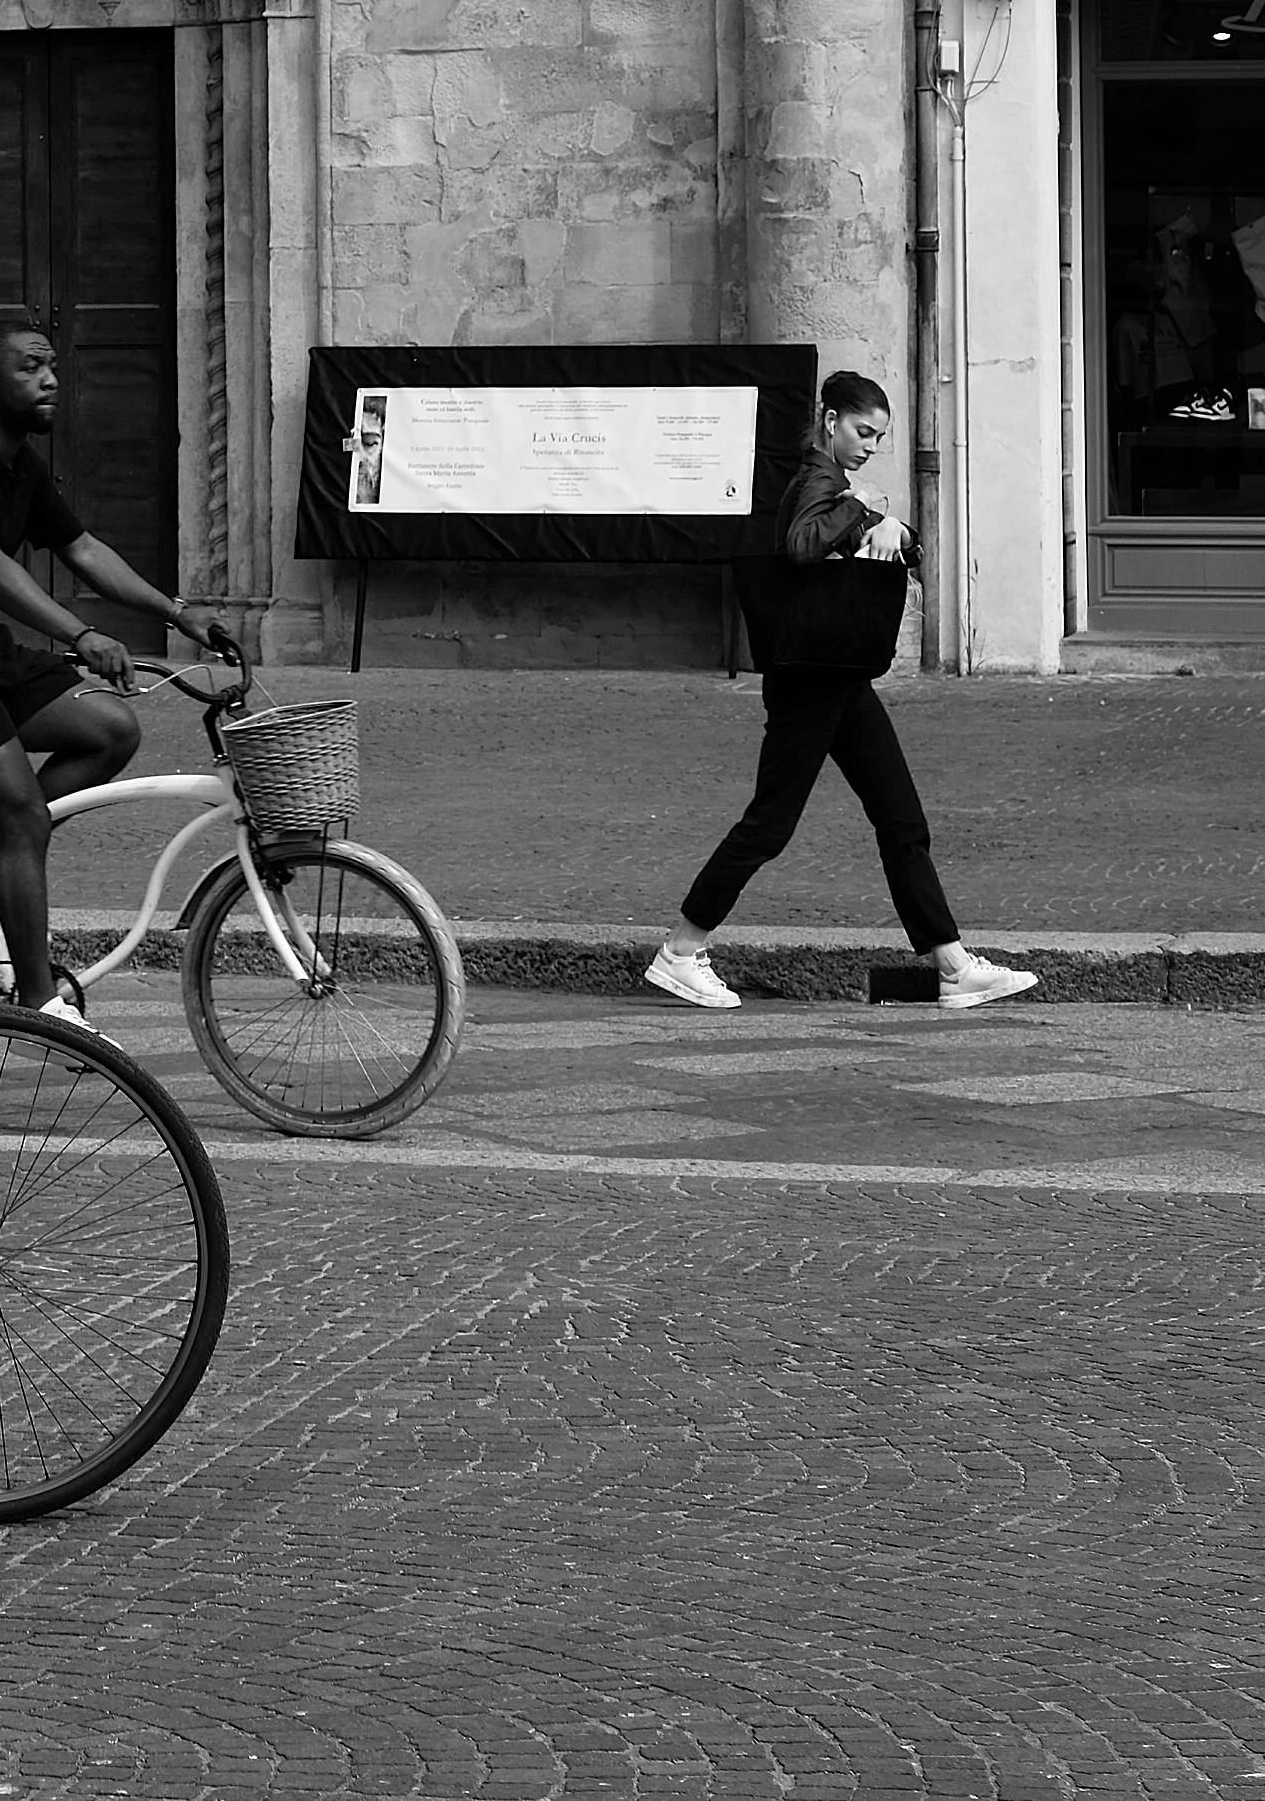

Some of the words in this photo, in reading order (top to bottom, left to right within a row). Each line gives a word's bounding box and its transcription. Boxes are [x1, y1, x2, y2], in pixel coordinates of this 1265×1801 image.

[533, 432, 546, 442] La
[550, 432, 567, 442] Via
[571, 432, 606, 442] Crucis
